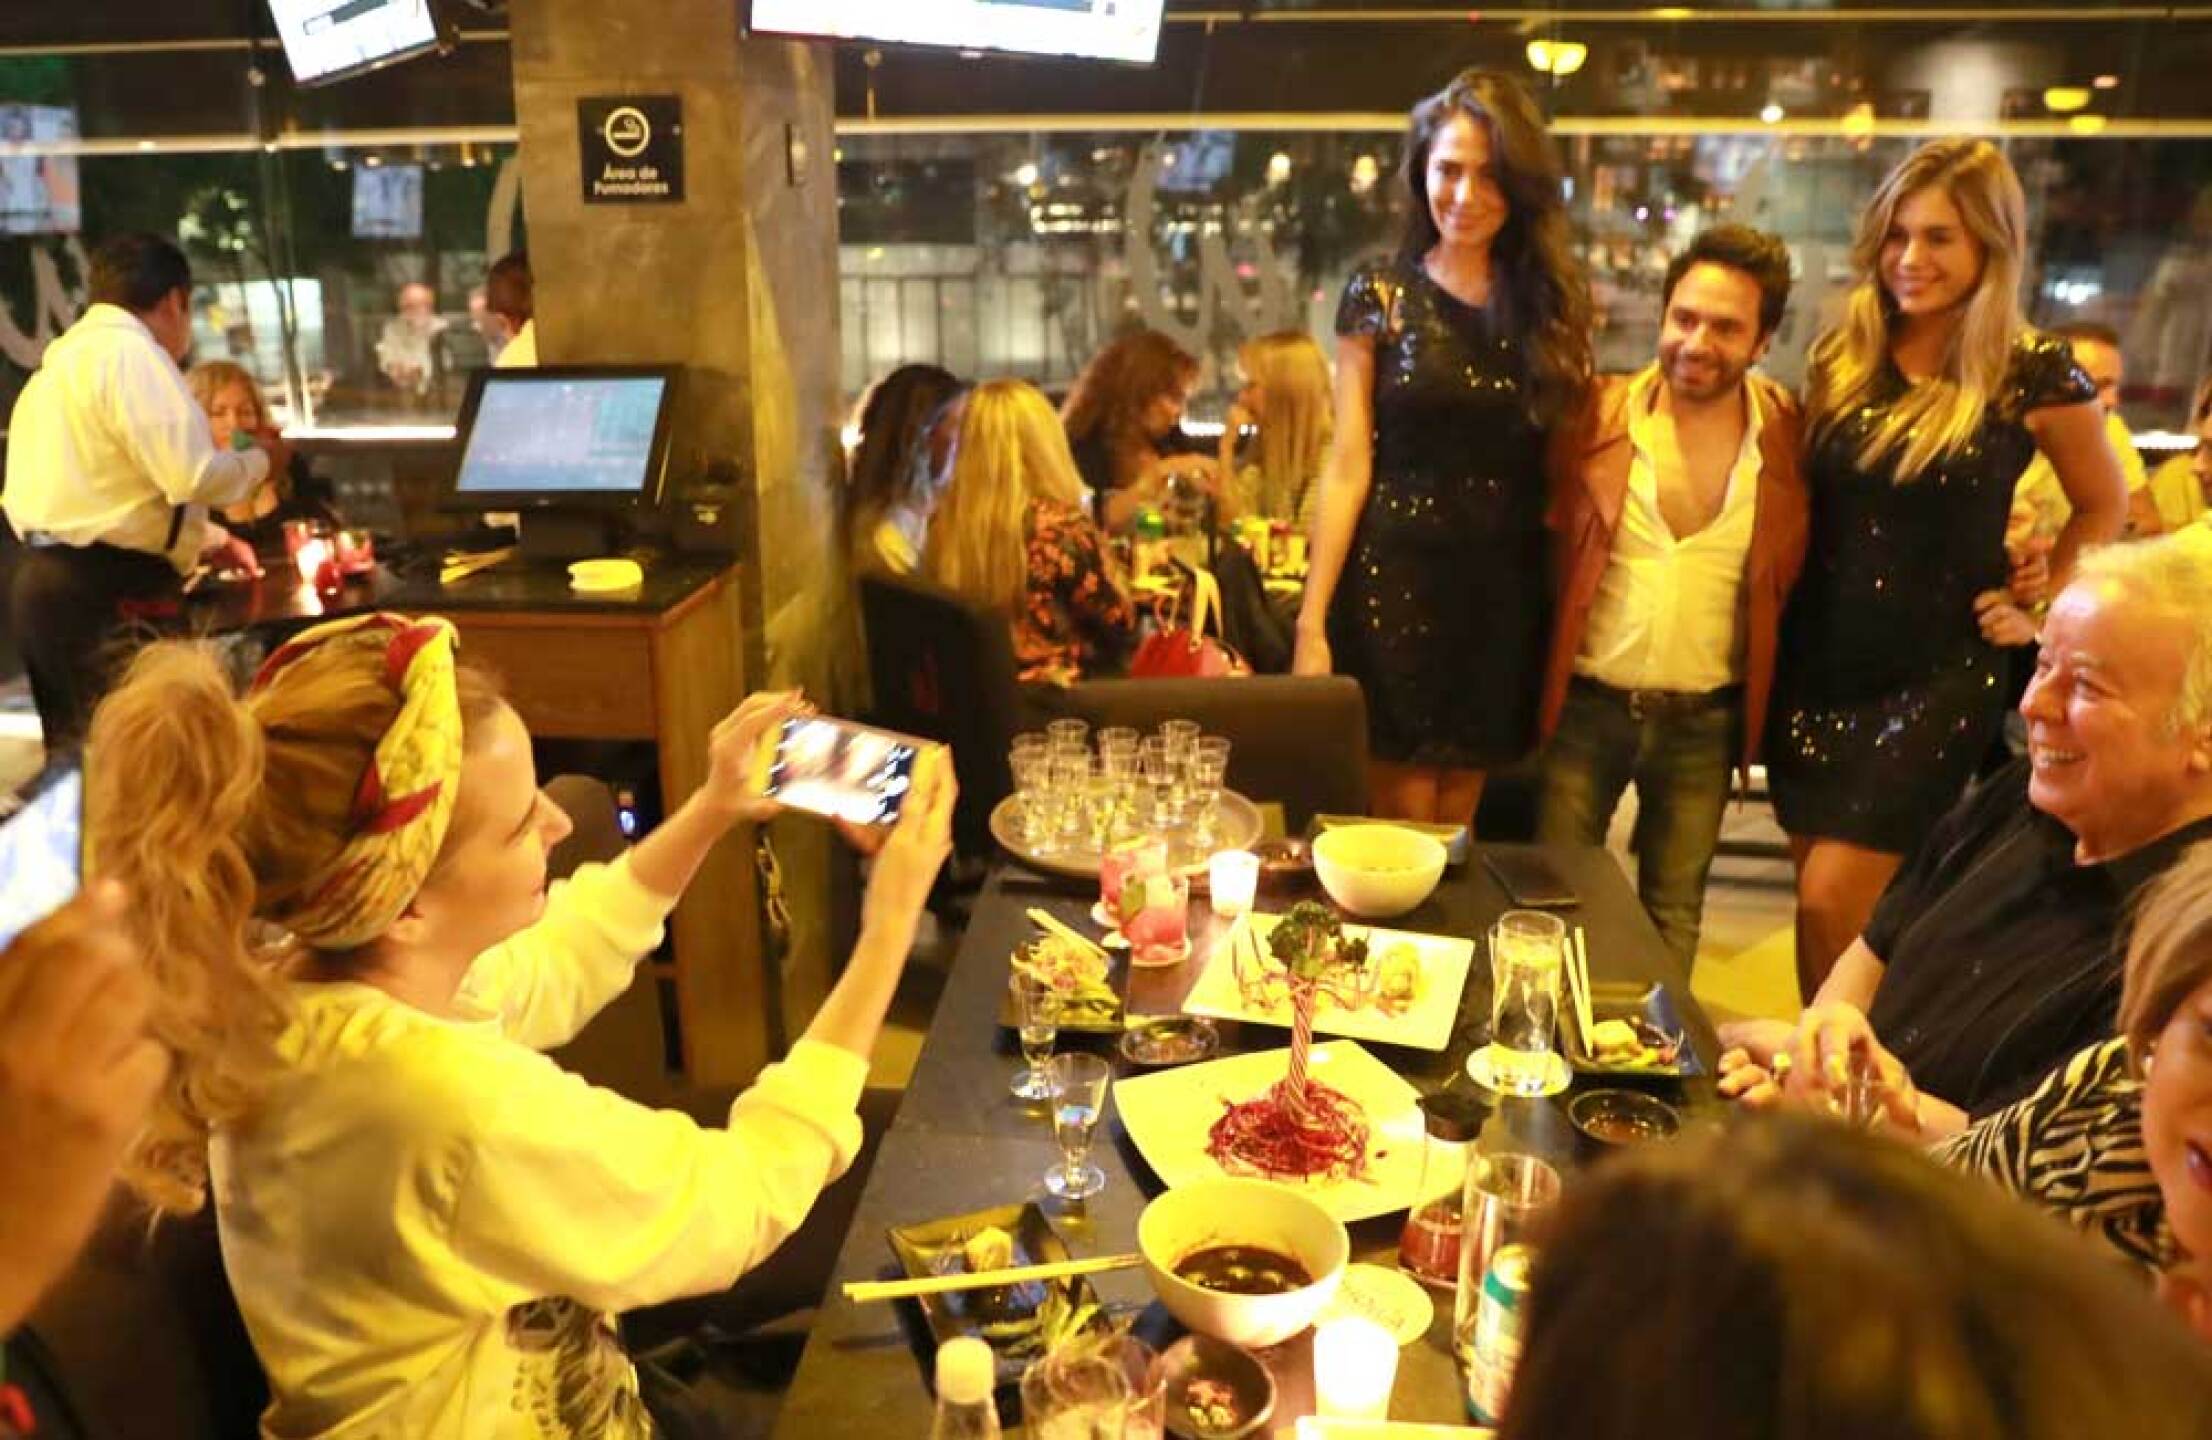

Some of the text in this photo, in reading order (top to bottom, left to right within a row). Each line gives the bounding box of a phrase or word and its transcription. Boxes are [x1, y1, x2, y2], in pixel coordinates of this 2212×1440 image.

[603, 161, 659, 180] Área de
[593, 180, 669, 196] Fumadores
